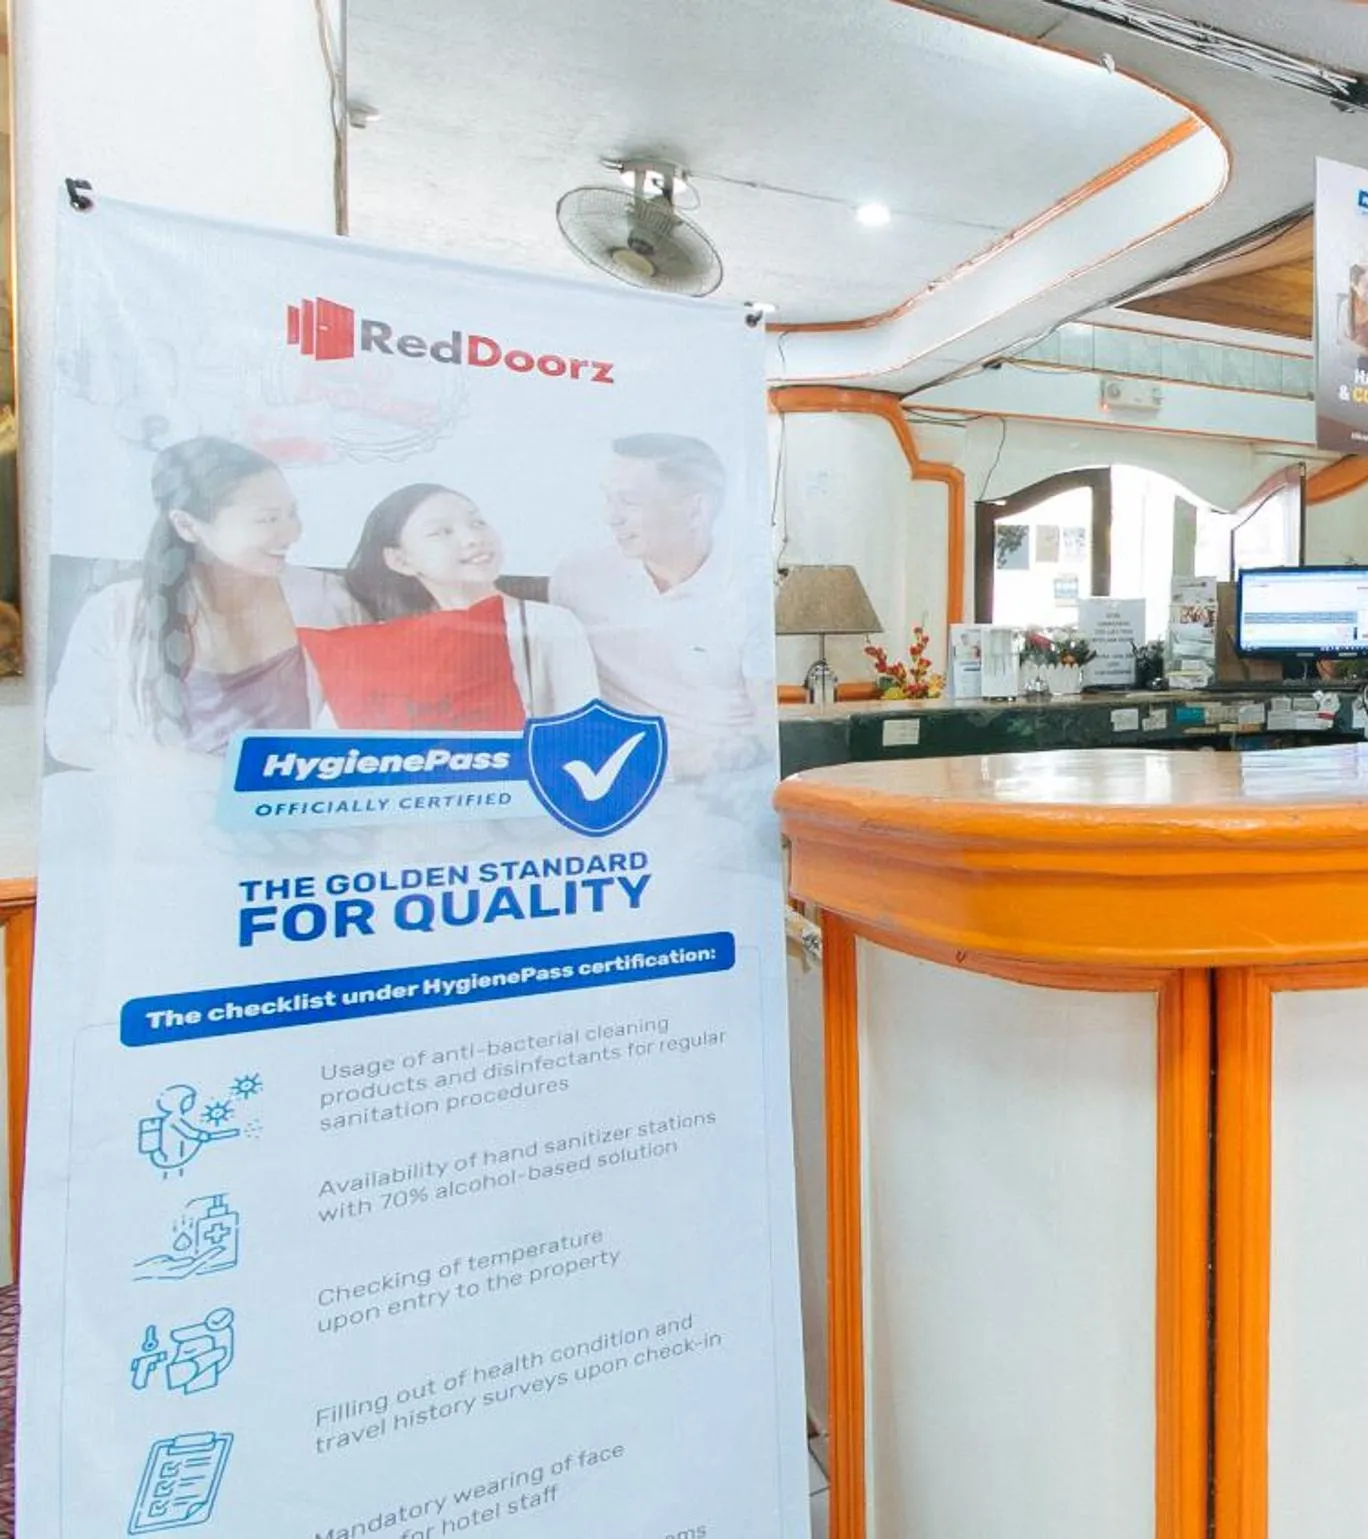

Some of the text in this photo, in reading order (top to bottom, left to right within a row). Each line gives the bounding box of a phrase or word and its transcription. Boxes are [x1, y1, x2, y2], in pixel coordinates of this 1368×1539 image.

[360, 318, 614, 384] RedDoorz
[1339, 384, 1350, 401] &
[262, 748, 511, 782] HygienePass
[255, 792, 512, 817] OFFICIALLY CERTIFIED
[239, 851, 648, 902] THE GOLDEN STANDARD
[239, 873, 652, 947] FOR QUALITY
[145, 947, 716, 1030] The checklist under HygienePass certification:
[320, 1015, 670, 1081] Usage of anti-bacterial cleaning
[320, 1029, 727, 1110] products and disinfectants for regular
[320, 1076, 569, 1132] sanitation procedures
[318, 1110, 717, 1198] Availability of hand sanitizer stations
[318, 1139, 678, 1223] with 70% alcohol-based solution
[318, 1230, 603, 1307] Checking of temperature
[318, 1248, 622, 1333] upon entry to the property
[315, 1331, 722, 1454] travel history surveys upon check-in
[316, 1312, 694, 1427] Filling out of health condition and
[453, 1465, 544, 1504] wearing
[551, 1456, 574, 1477] of
[578, 1444, 626, 1468] face
[442, 1503, 500, 1537] hotel
[507, 1483, 560, 1515] staff
